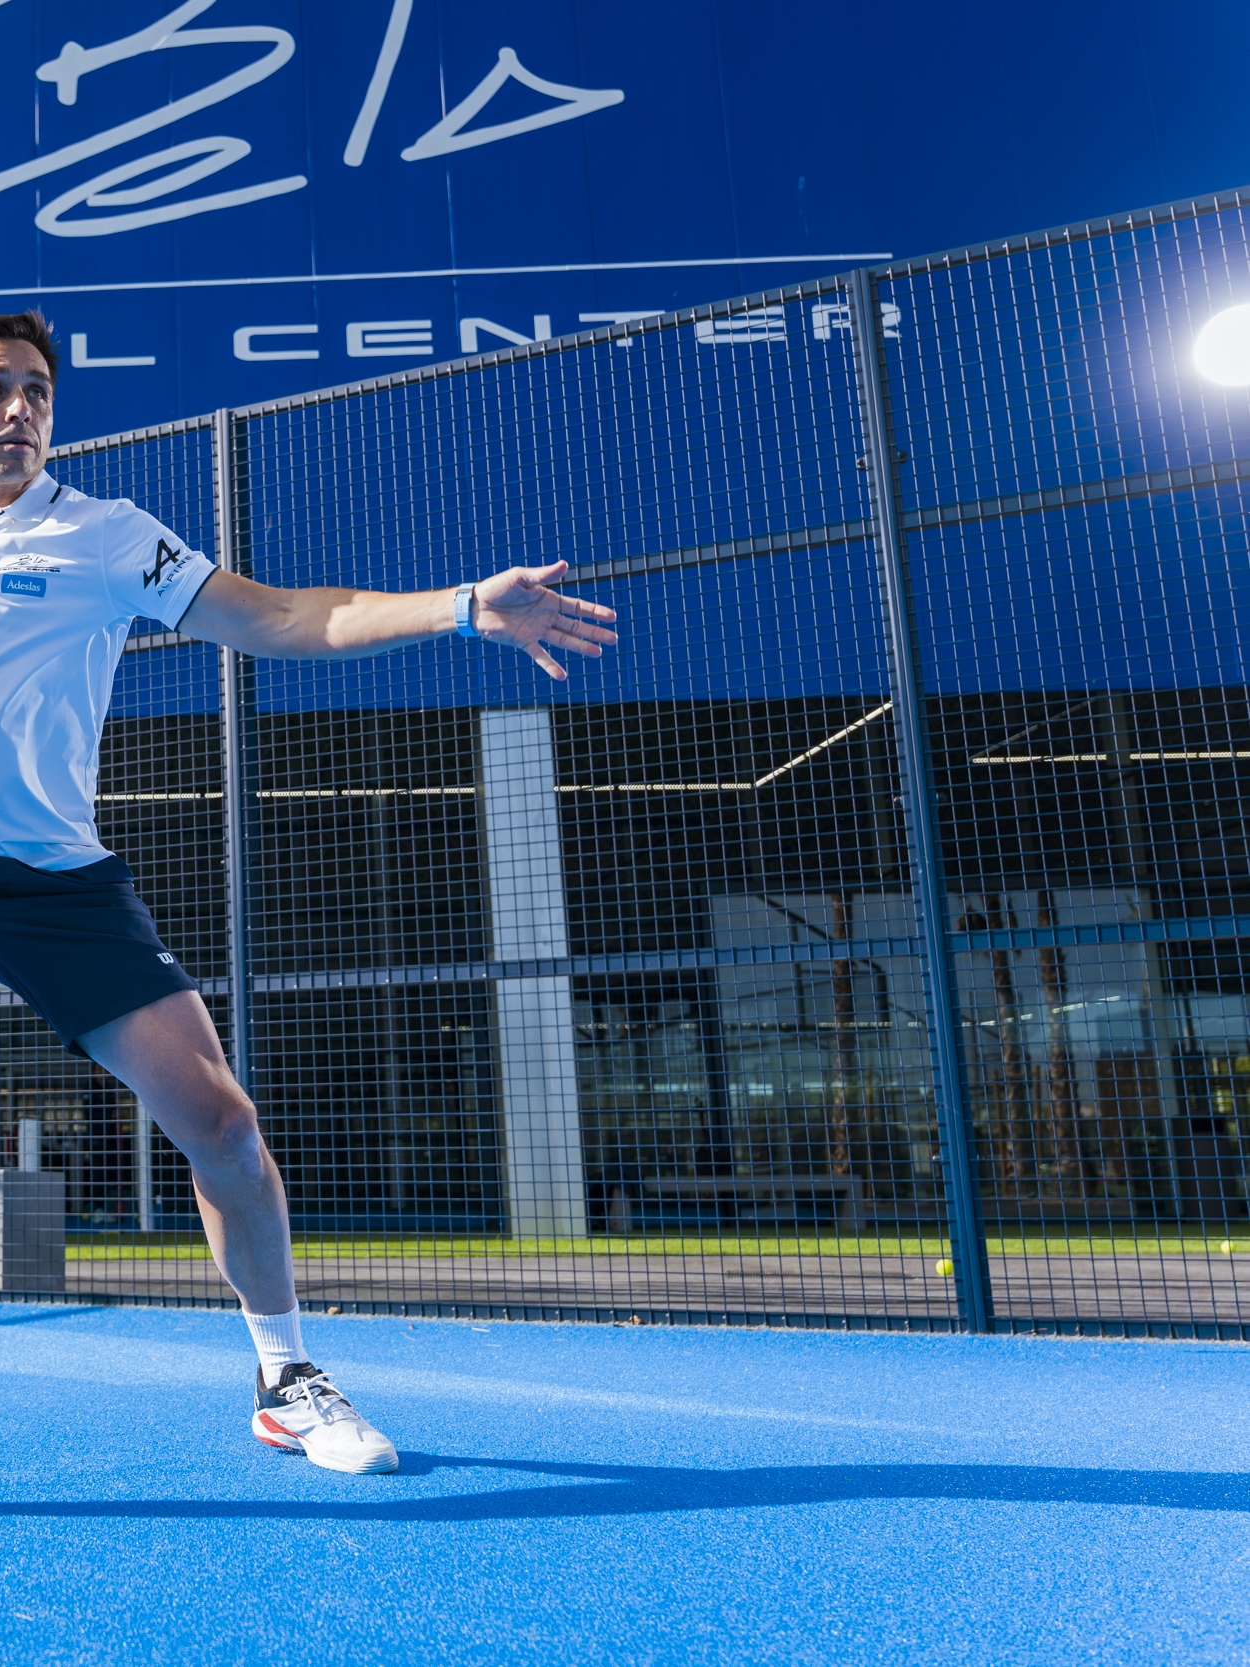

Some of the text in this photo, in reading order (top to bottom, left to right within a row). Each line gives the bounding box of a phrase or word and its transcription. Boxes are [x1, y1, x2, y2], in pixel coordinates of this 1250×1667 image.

[233, 302, 903, 361] CENTER
[6, 579, 41, 592] Adeslas
[157, 555, 193, 597] ALPINE
